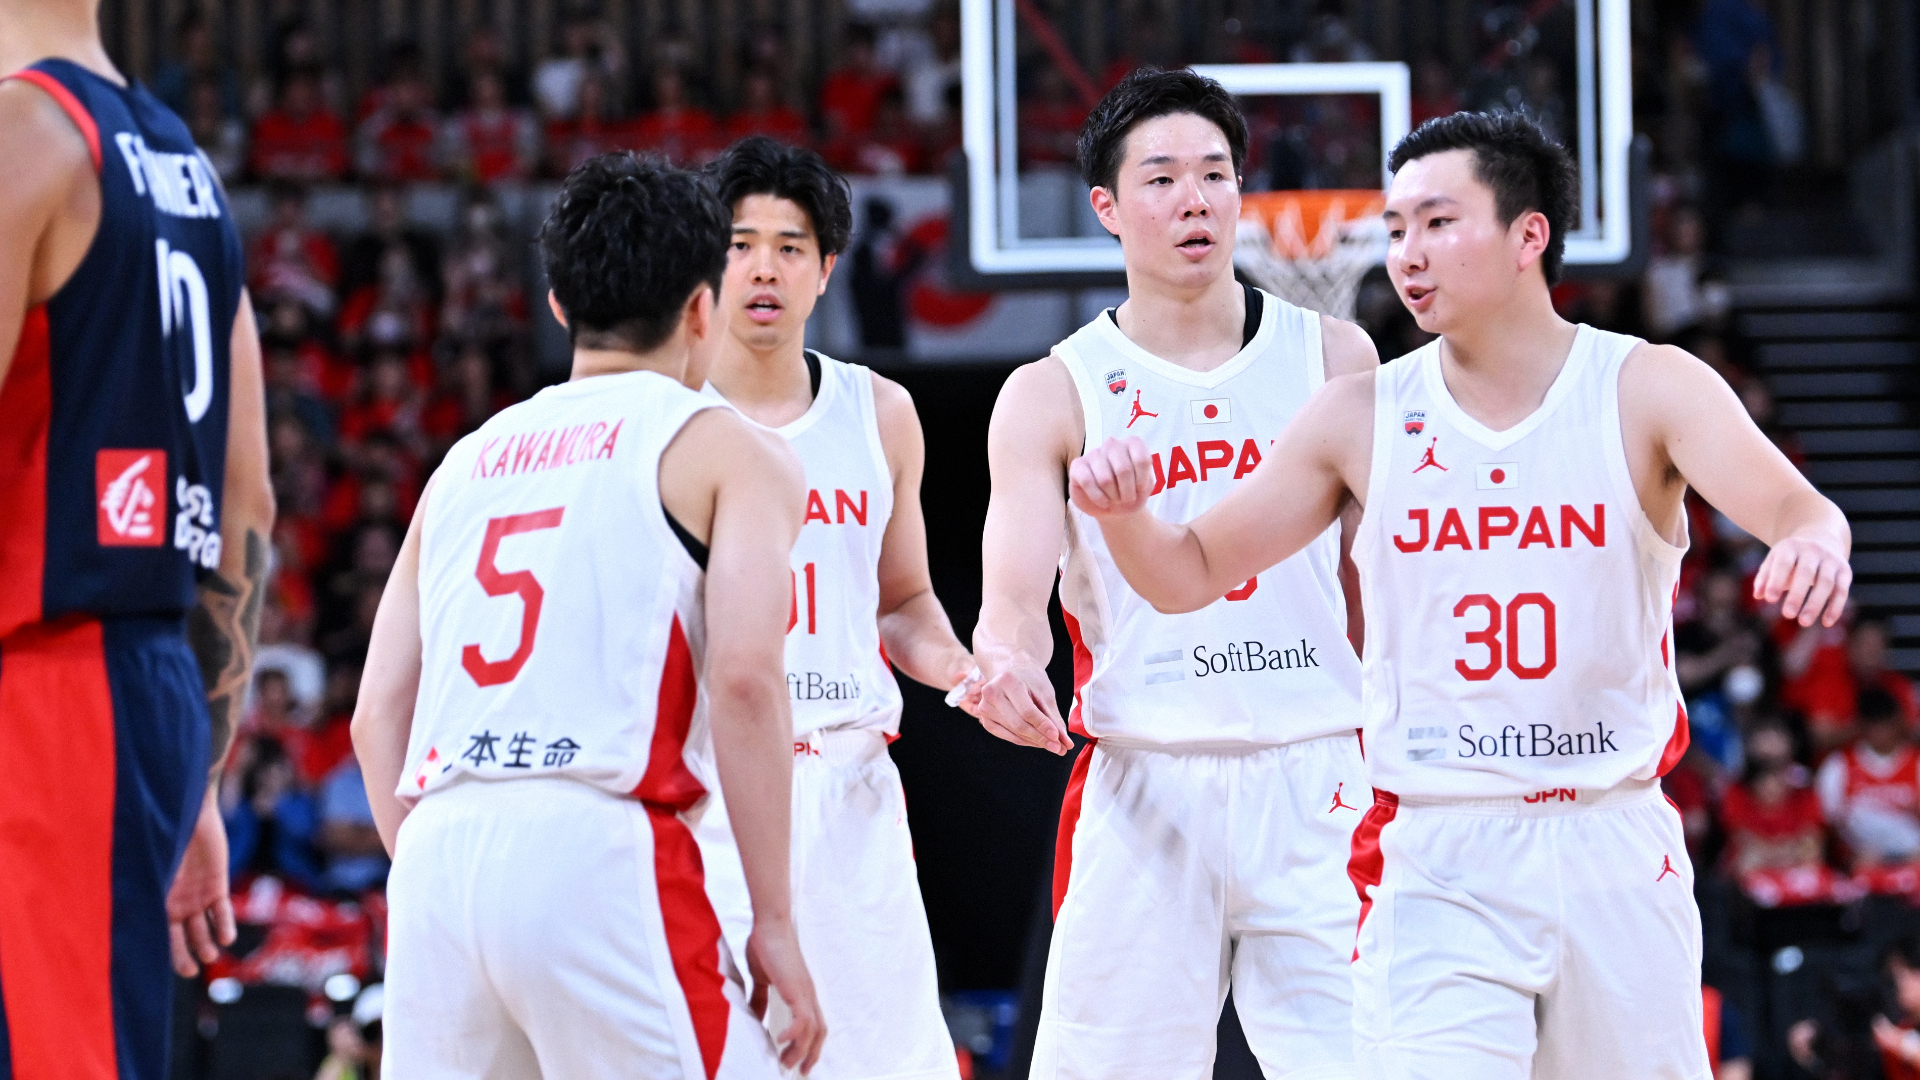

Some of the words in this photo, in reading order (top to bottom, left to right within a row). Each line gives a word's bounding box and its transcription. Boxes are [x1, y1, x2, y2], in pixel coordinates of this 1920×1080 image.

[471, 418, 625, 480] KAWAMURA
[1149, 438, 1275, 497] JAPA
[1393, 503, 1605, 553] JAPAN
[461, 505, 566, 688] 5
[1193, 639, 1319, 677] SoftBank
[1453, 592, 1557, 681] 30
[787, 672, 861, 700] ftBank
[443, 729, 581, 773] 本生命
[1458, 721, 1619, 758] SoftBank
[1523, 788, 1576, 804] JPN
